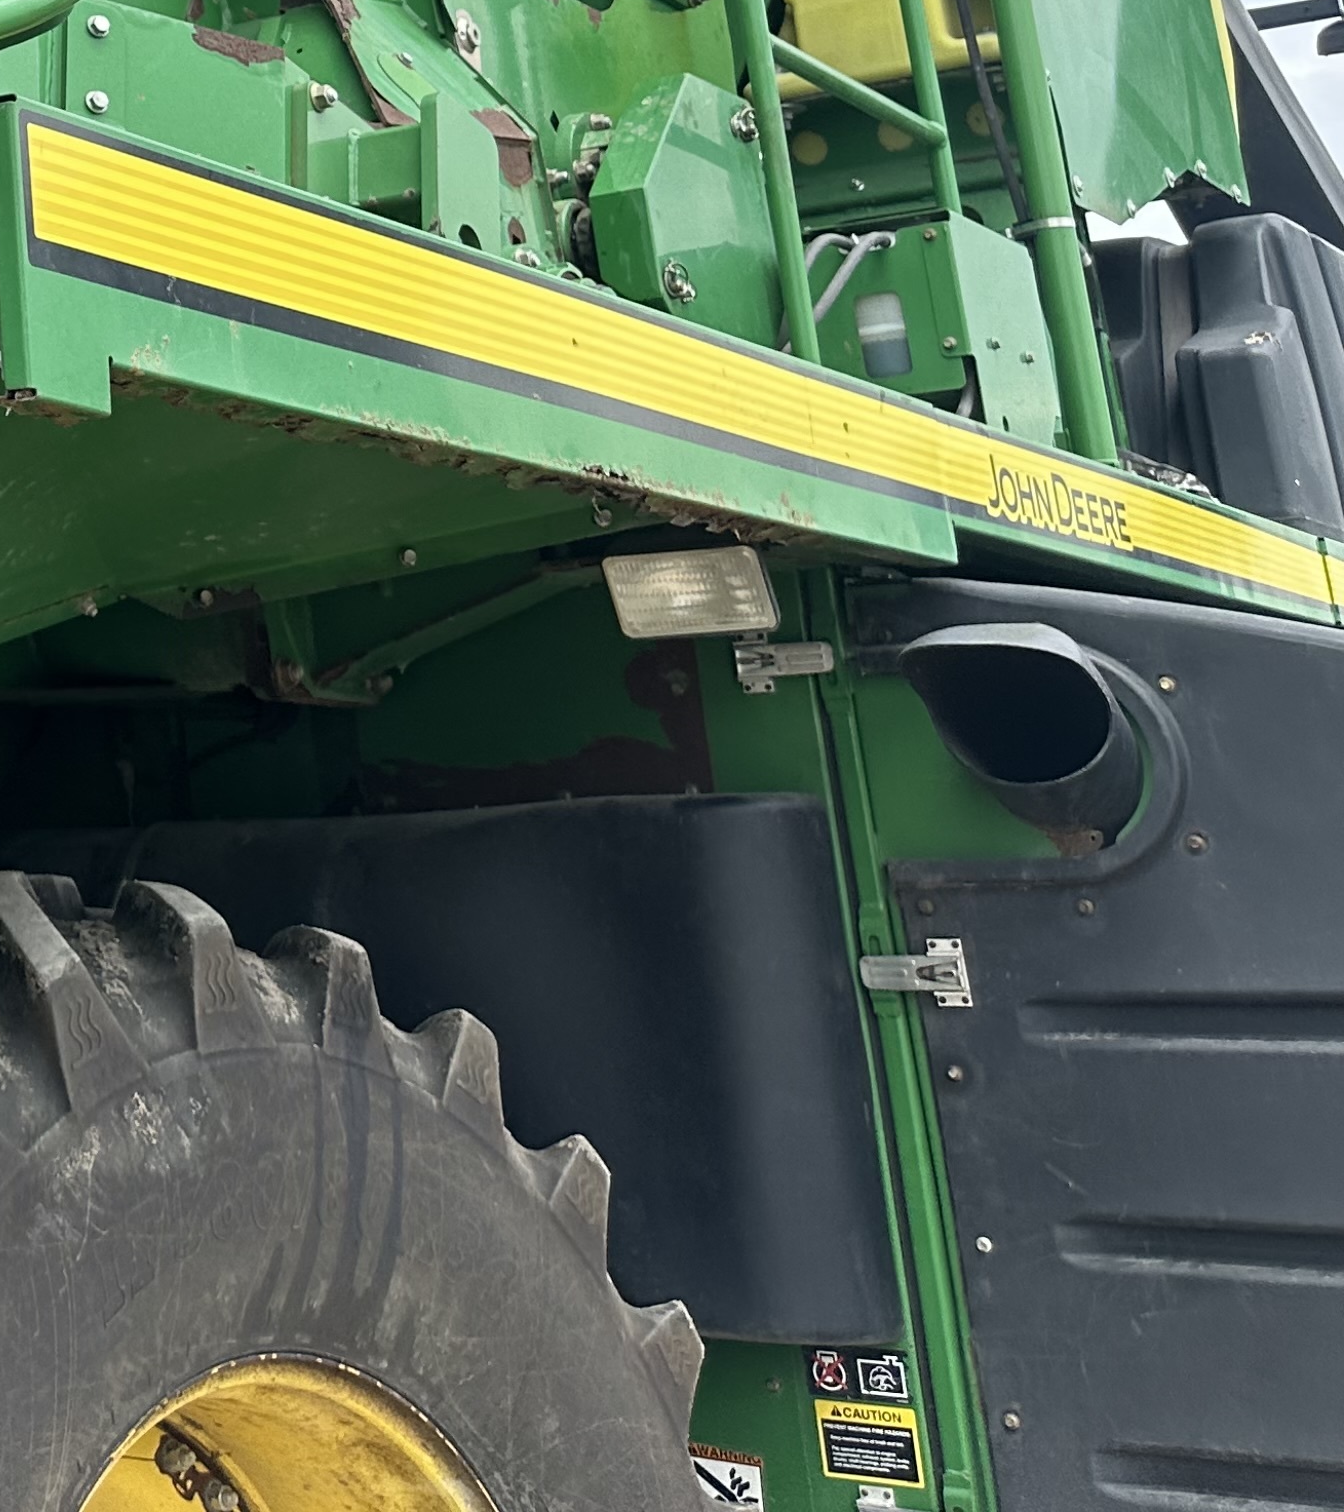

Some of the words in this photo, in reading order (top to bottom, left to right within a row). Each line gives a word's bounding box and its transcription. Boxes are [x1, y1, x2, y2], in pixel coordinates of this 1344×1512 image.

[988, 454, 1054, 523] JOHN
[1051, 472, 1132, 543] DEERE
[842, 1407, 902, 1423] CAUTION
[697, 1444, 761, 1464] WARNING
